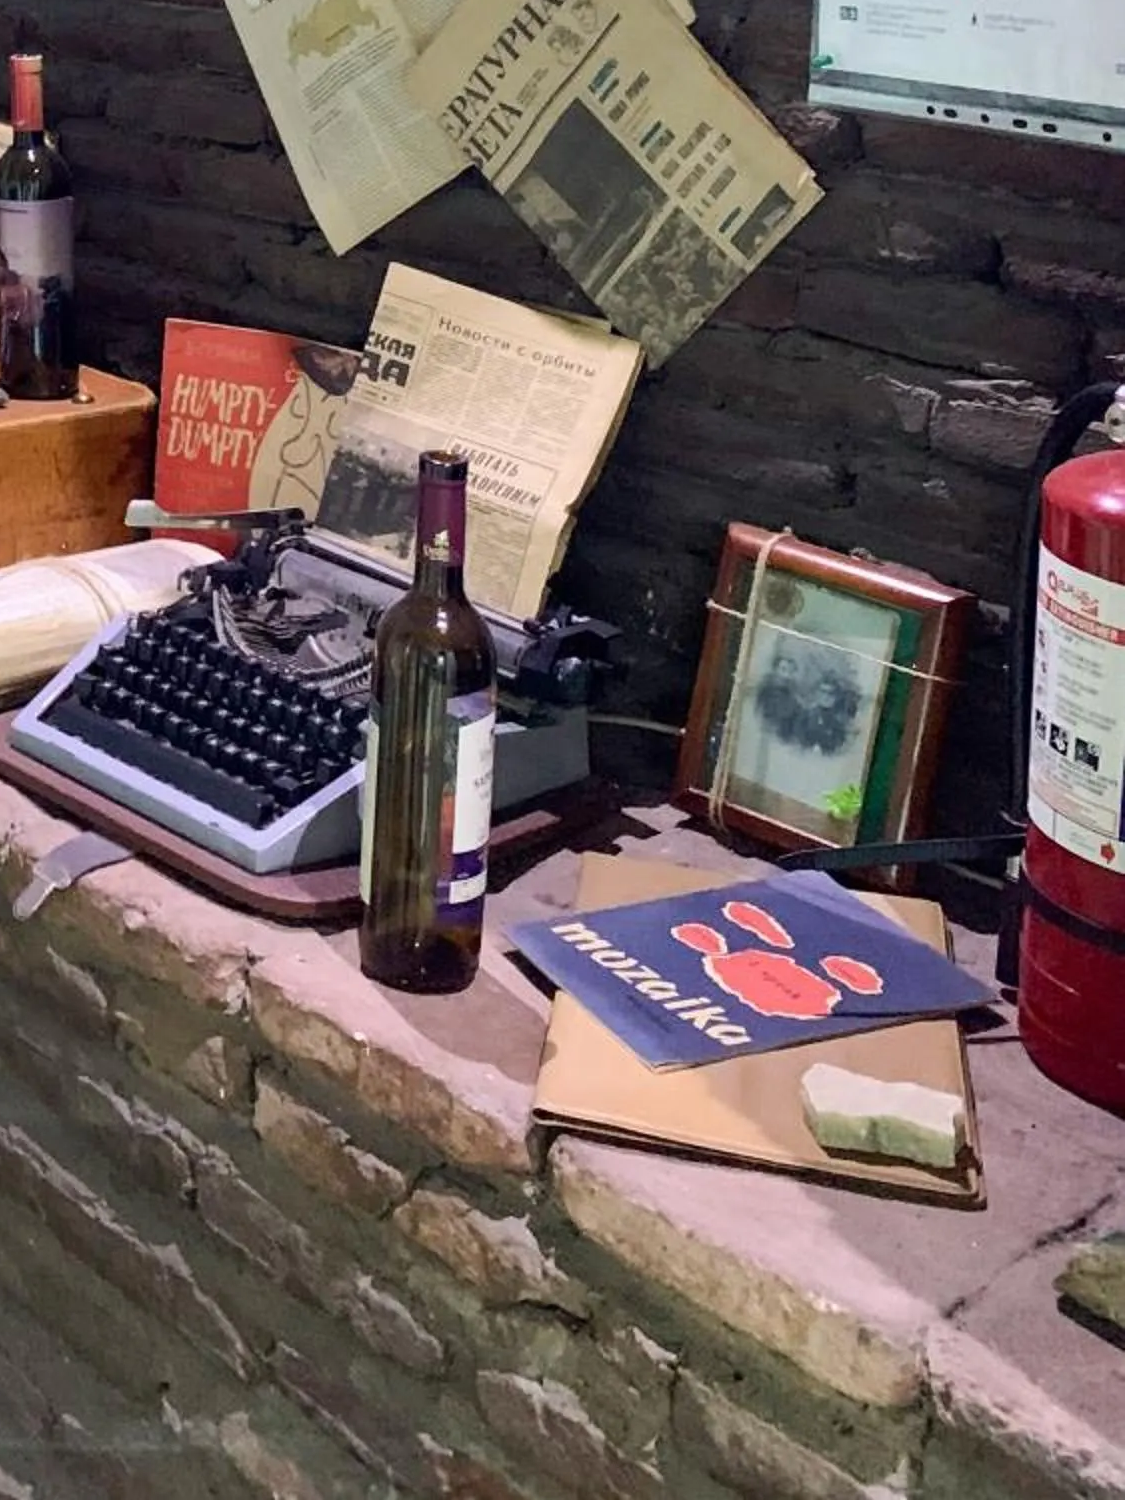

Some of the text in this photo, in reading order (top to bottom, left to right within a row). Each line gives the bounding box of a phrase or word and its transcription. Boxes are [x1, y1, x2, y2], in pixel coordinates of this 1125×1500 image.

[438, 316, 511, 352] Новости
[531, 350, 598, 378] орбиты
[170, 373, 277, 426] HUMPTY-
[166, 417, 263, 470] DUMPTY
[551, 922, 753, 1047] mozaika
